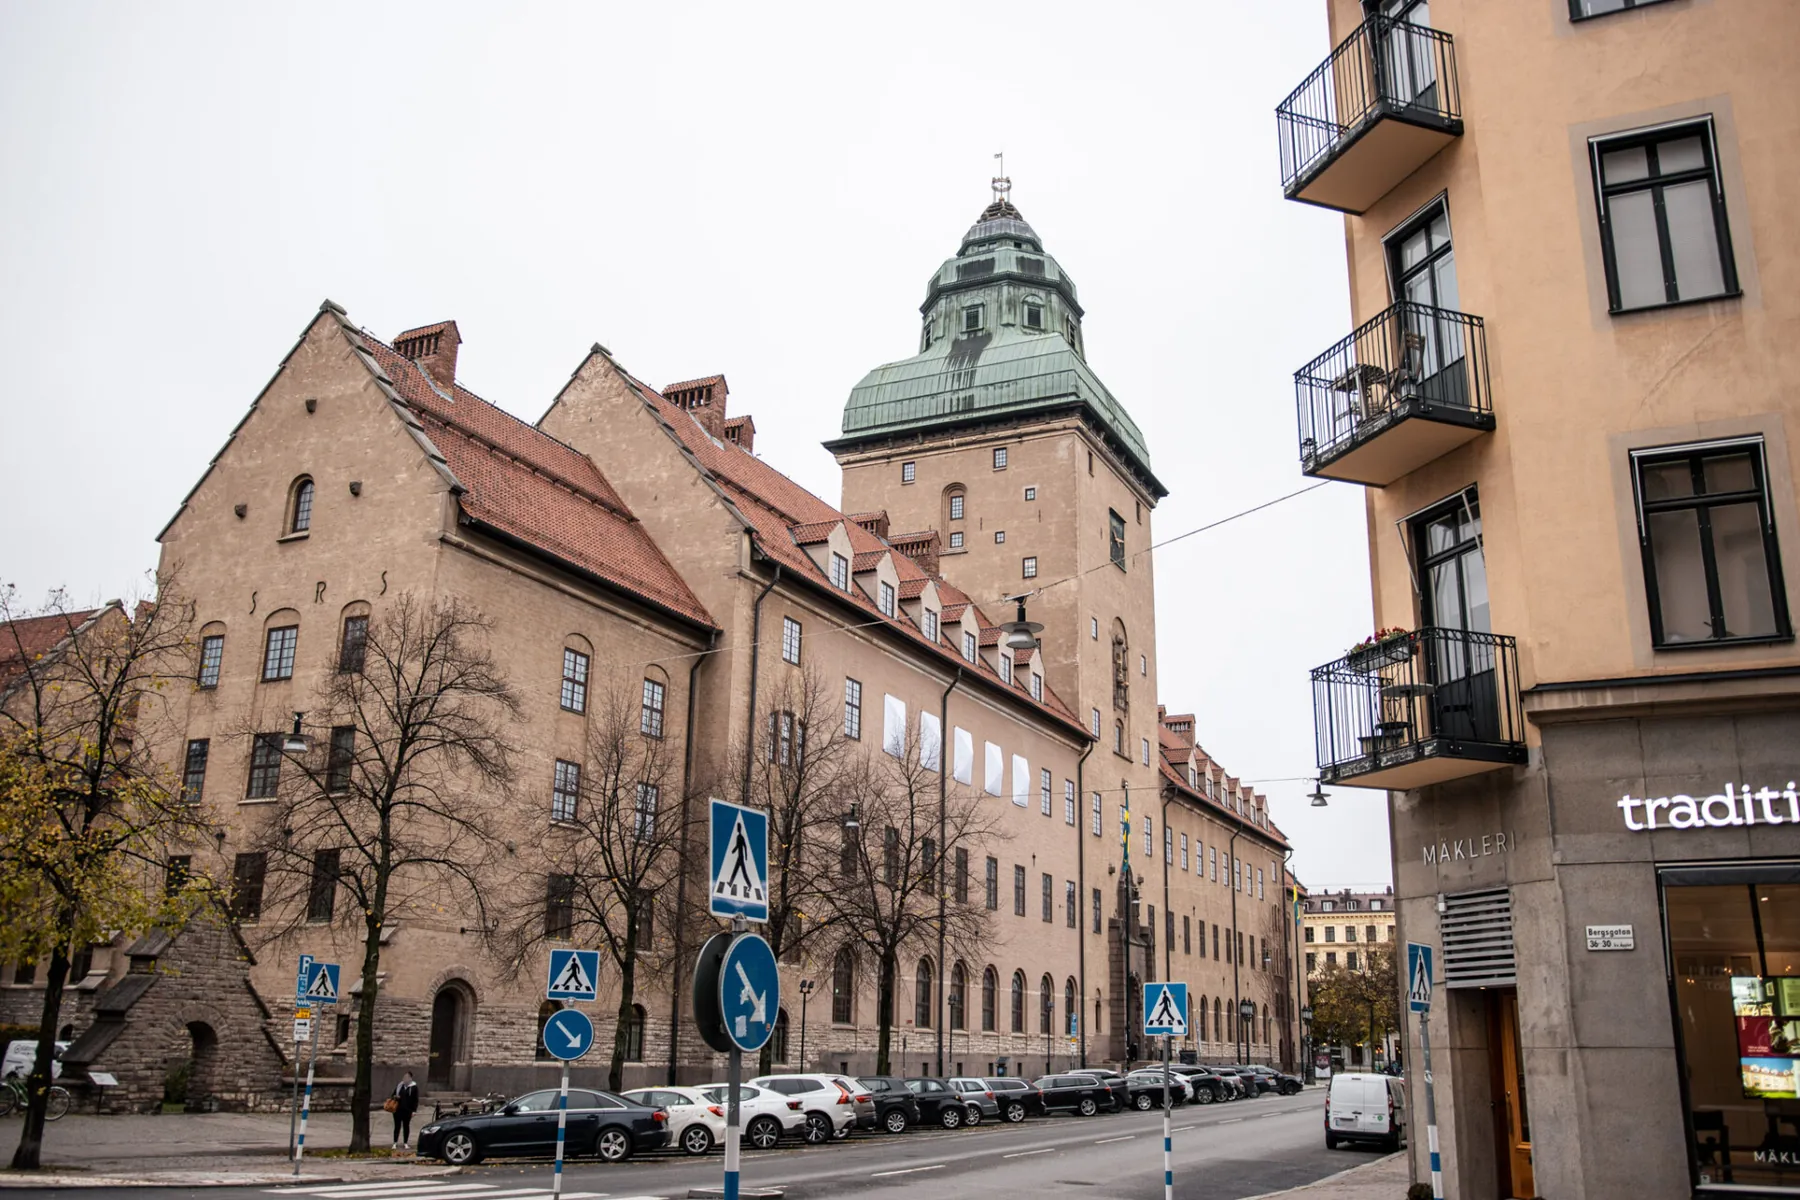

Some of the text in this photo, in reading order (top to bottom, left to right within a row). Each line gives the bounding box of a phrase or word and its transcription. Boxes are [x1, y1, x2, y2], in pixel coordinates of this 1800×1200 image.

[1617, 781, 1800, 831] traditi
[1422, 829, 1517, 866] MÄKLERI
[1588, 928, 1631, 937] Bergsgatan
[1753, 1148, 1800, 1164] MÄKL
